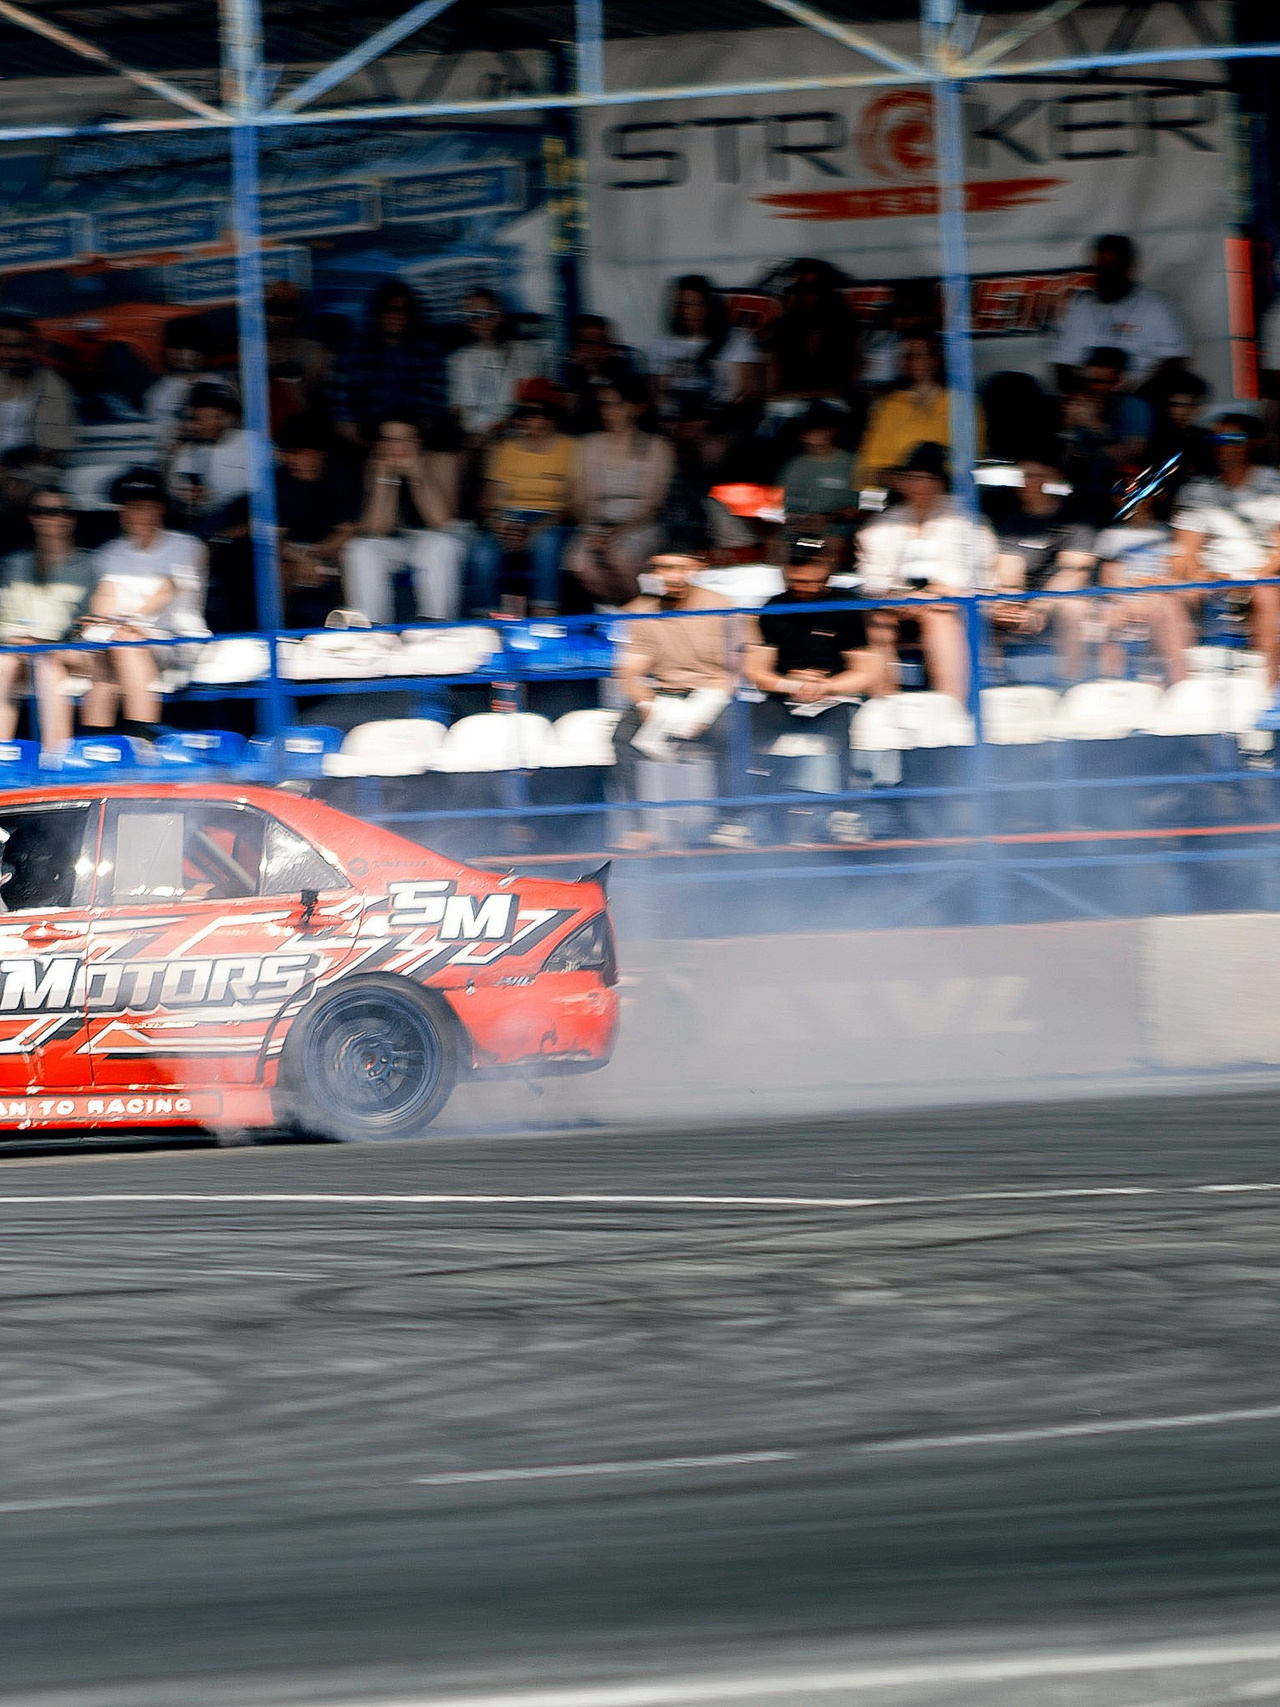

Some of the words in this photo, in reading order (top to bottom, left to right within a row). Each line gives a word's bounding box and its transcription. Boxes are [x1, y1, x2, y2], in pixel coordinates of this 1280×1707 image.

[388, 880, 518, 942] SM
[39, 1100, 75, 1116] TO
[87, 1098, 192, 1115] RACING
